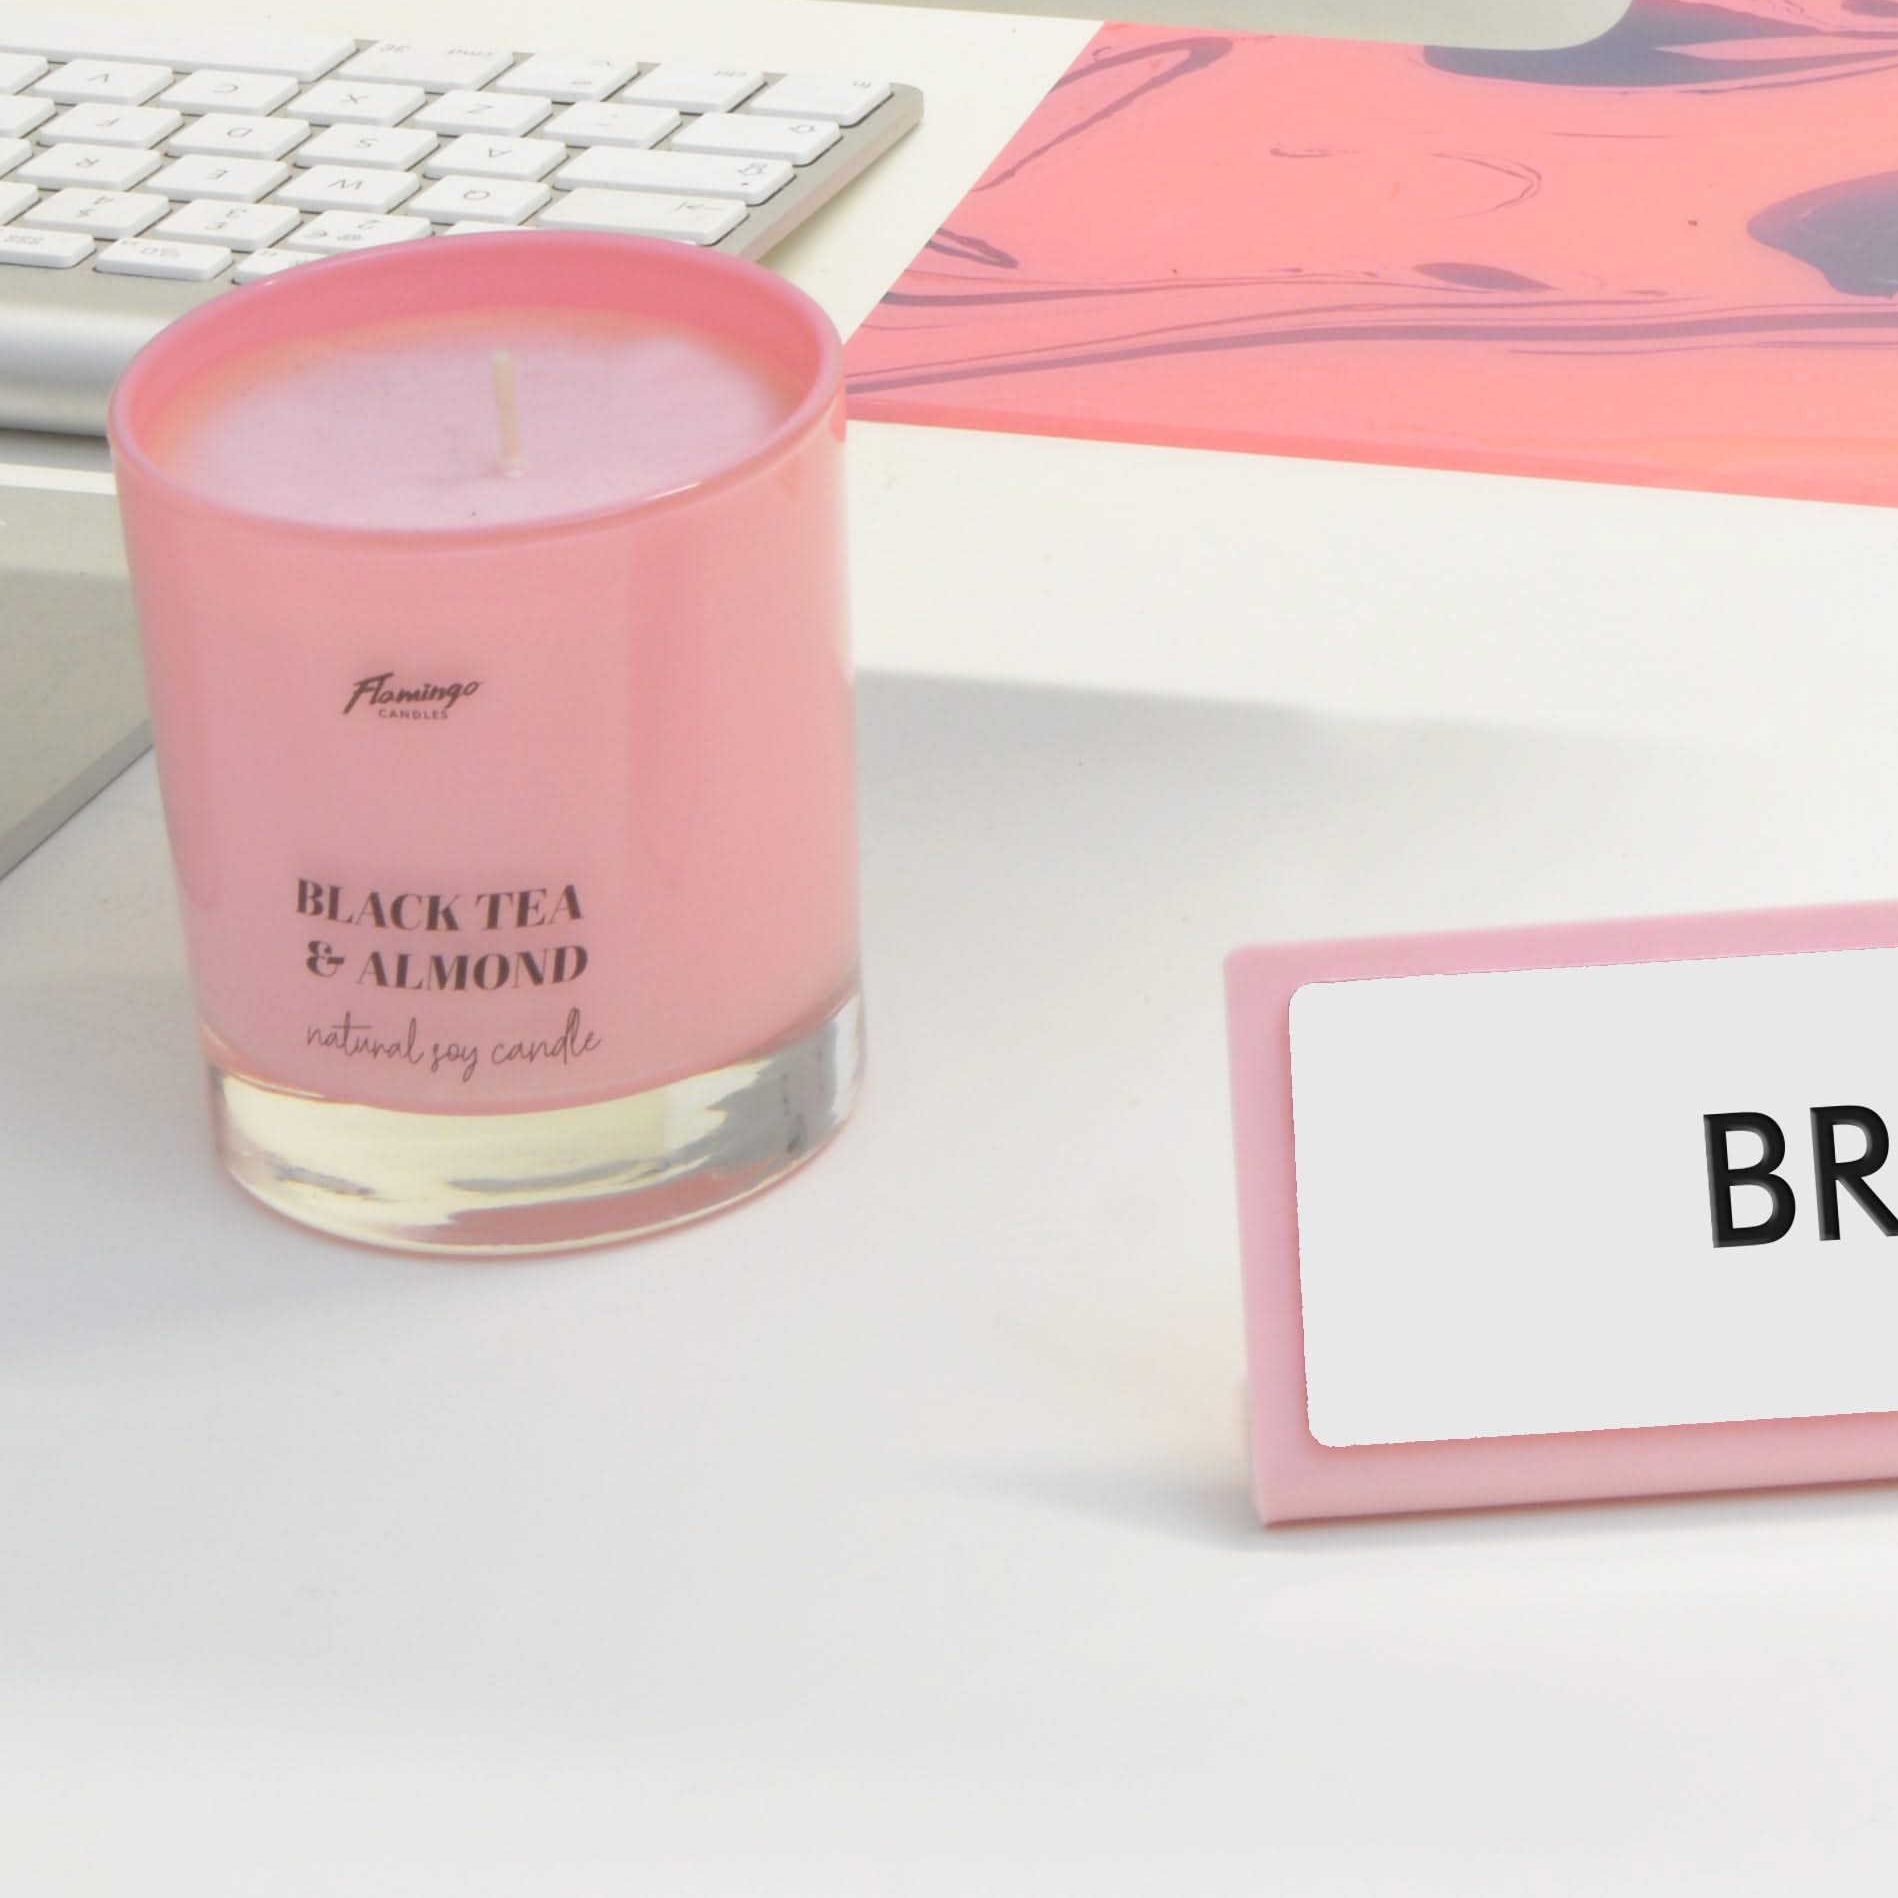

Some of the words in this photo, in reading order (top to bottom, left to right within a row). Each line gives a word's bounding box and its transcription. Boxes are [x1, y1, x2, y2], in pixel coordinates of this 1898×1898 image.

[341, 671, 483, 715] Flamingo
[377, 708, 450, 720] CANDLES
[296, 878, 461, 932] BLACK
[475, 883, 584, 932] TEA
[306, 940, 345, 978] &
[356, 944, 590, 992] ALMOND
[306, 1010, 424, 1065] natural
[431, 1039, 480, 1082] soy
[491, 1006, 602, 1067] candle
